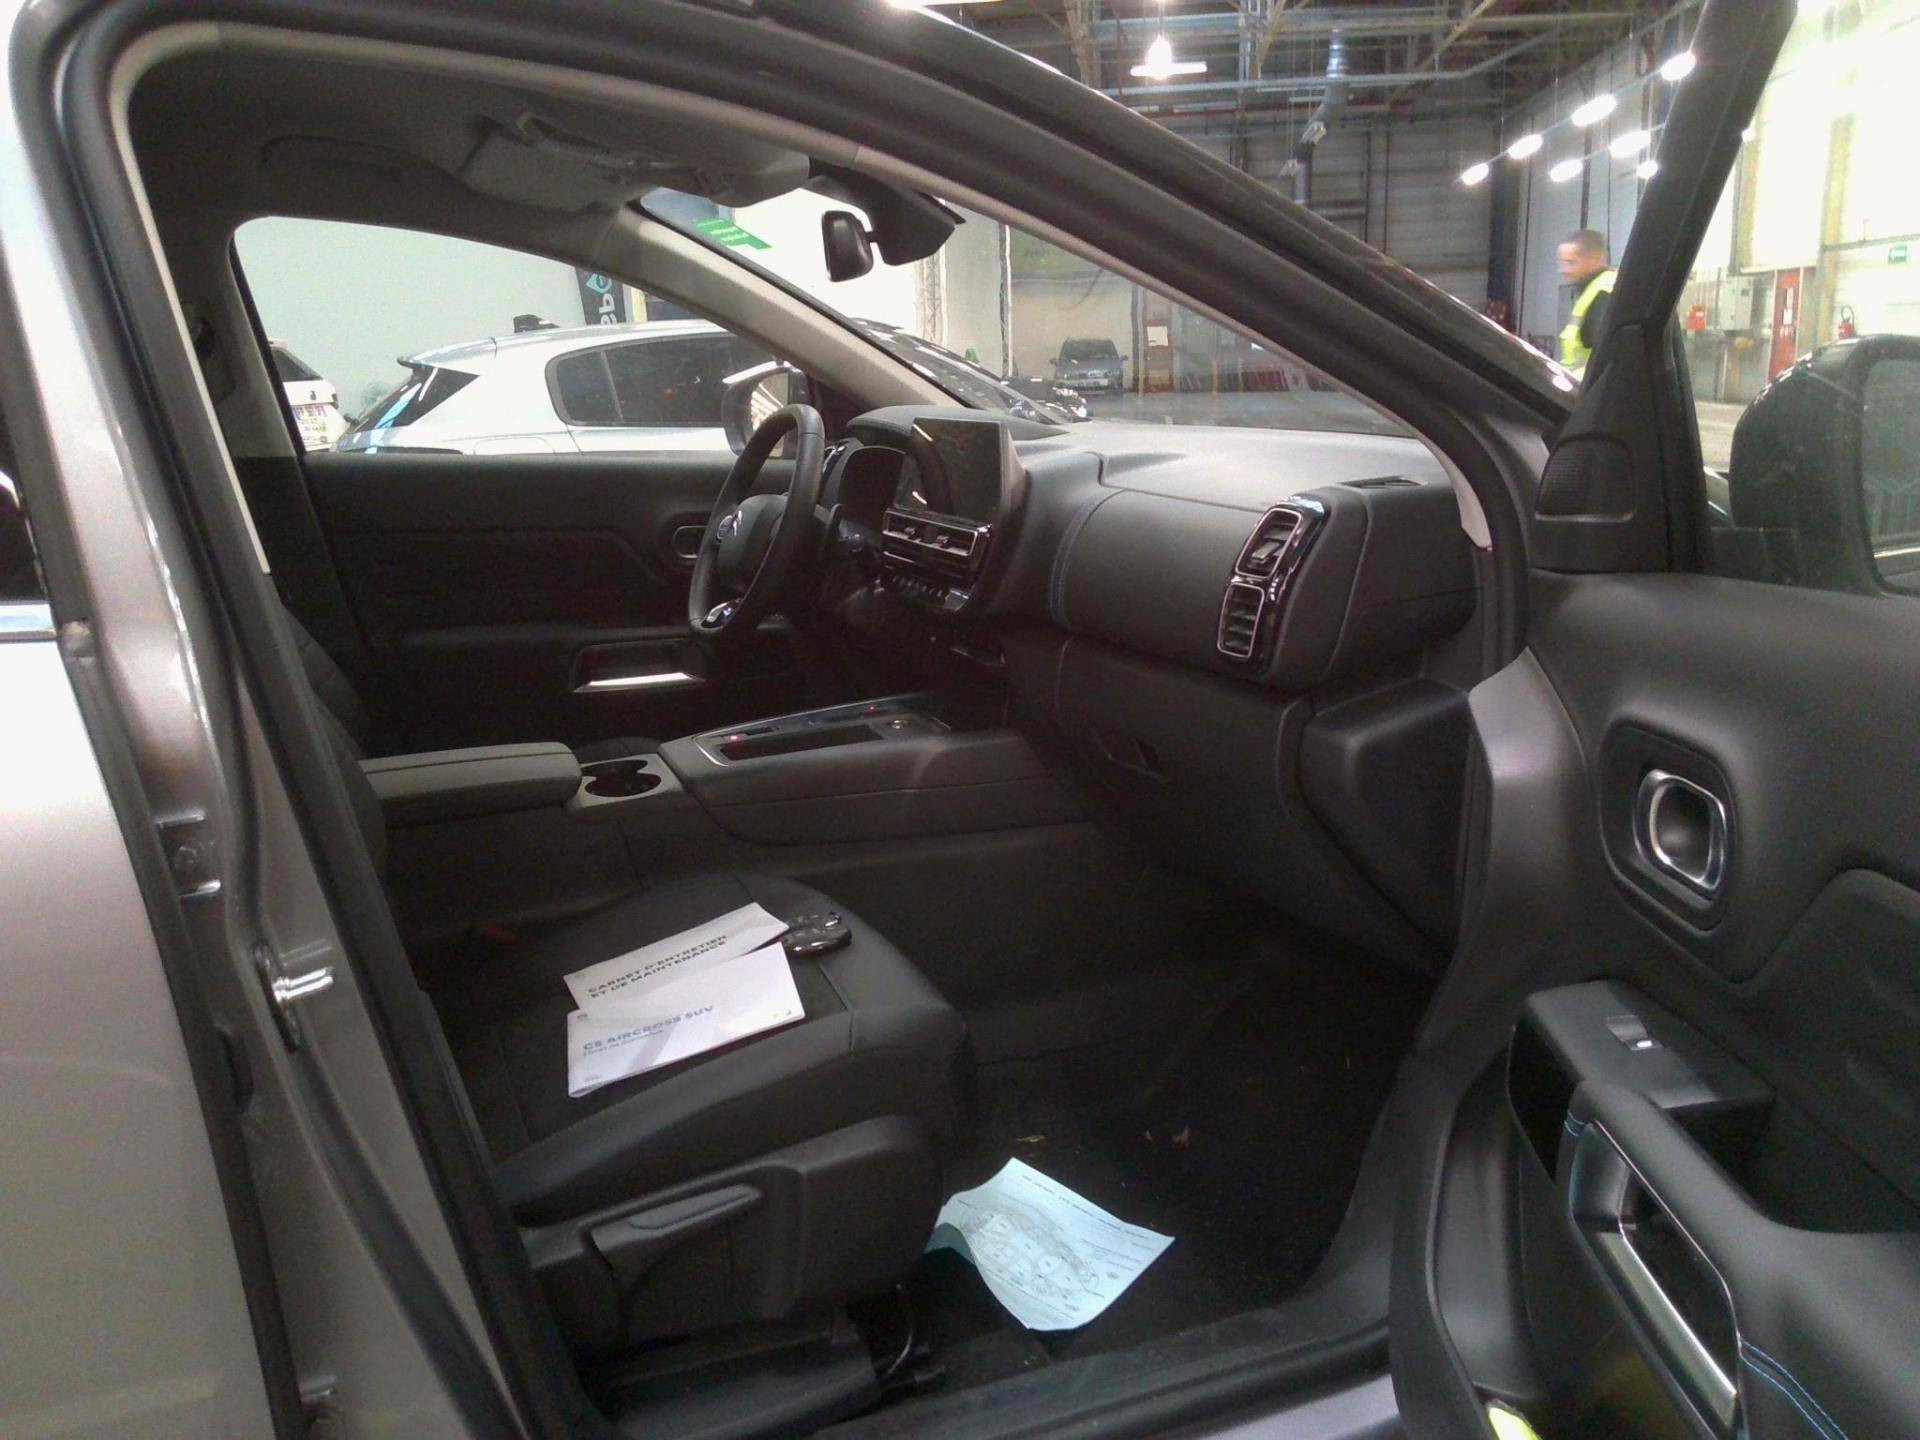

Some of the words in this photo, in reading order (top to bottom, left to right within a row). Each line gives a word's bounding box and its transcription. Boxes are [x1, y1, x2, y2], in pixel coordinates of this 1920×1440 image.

[631, 941, 726, 982] MAINTENANCE
[588, 970, 640, 992] CARNET
[607, 1016, 682, 1043] AIRCROSS
[685, 1005, 714, 1019] SUV
